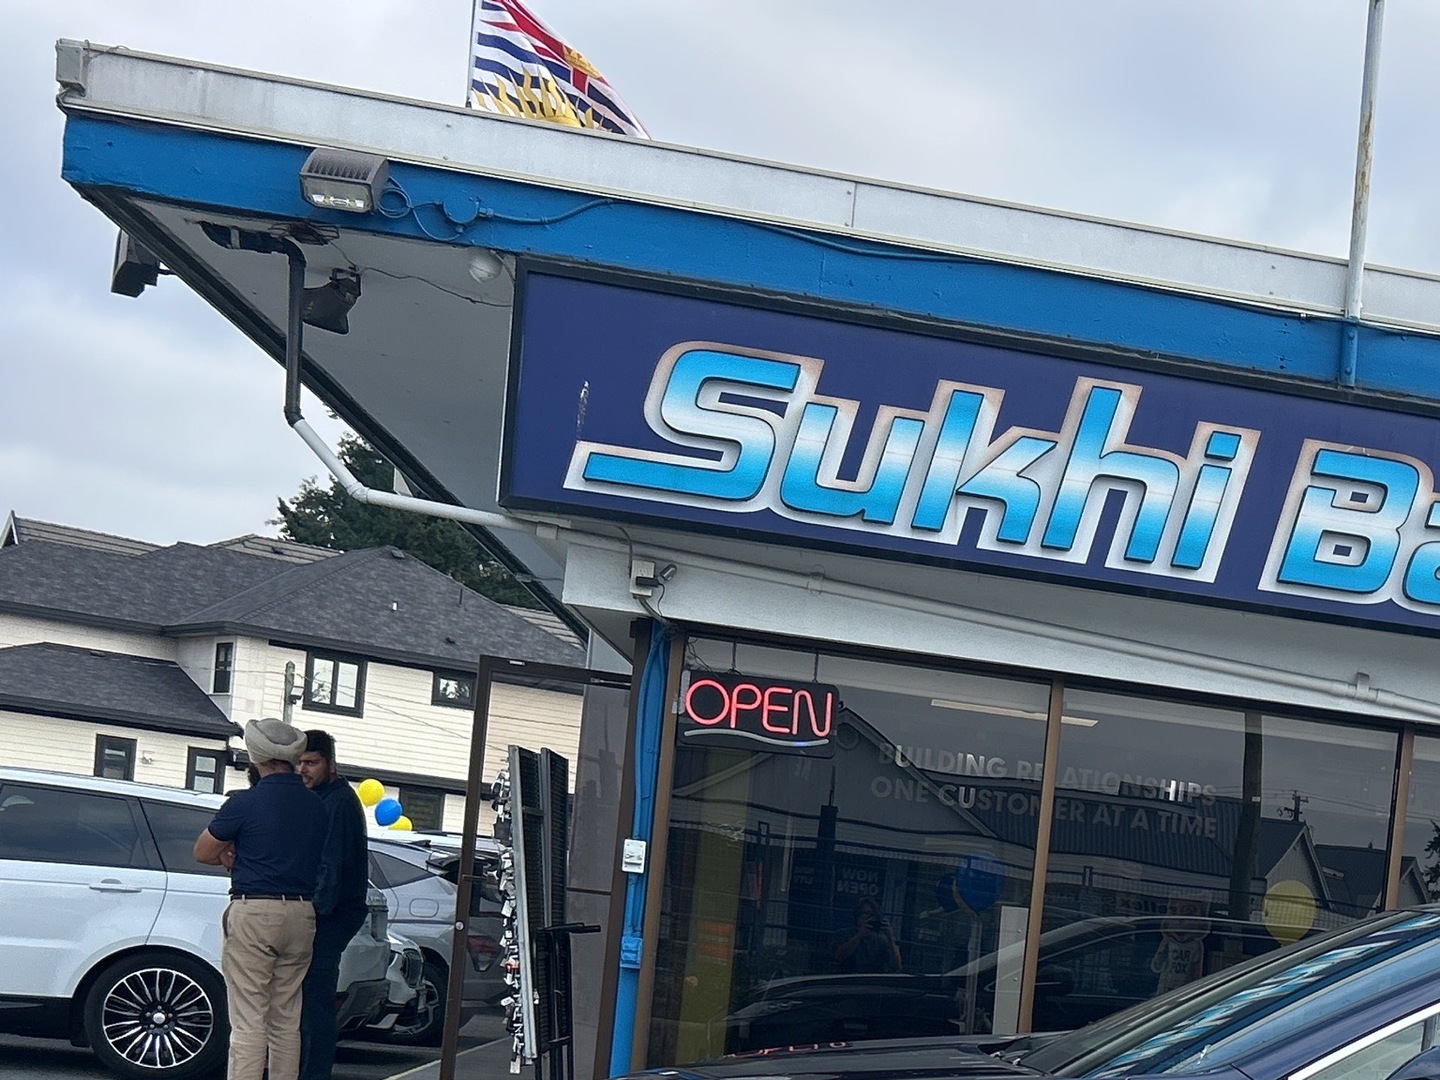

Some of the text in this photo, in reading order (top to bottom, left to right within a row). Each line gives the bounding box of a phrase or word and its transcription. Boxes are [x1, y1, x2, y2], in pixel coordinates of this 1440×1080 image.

[564, 342, 1260, 583] Sukhi
[684, 679, 833, 737] OPEN
[878, 743, 1217, 807] BUILDING REATIONSHIPS
[871, 776, 929, 803] ONE
[1092, 804, 1126, 828] AT
[1130, 808, 1149, 831] A
[1157, 810, 1218, 840] TIME
[1172, 949, 1191, 961] CAR
